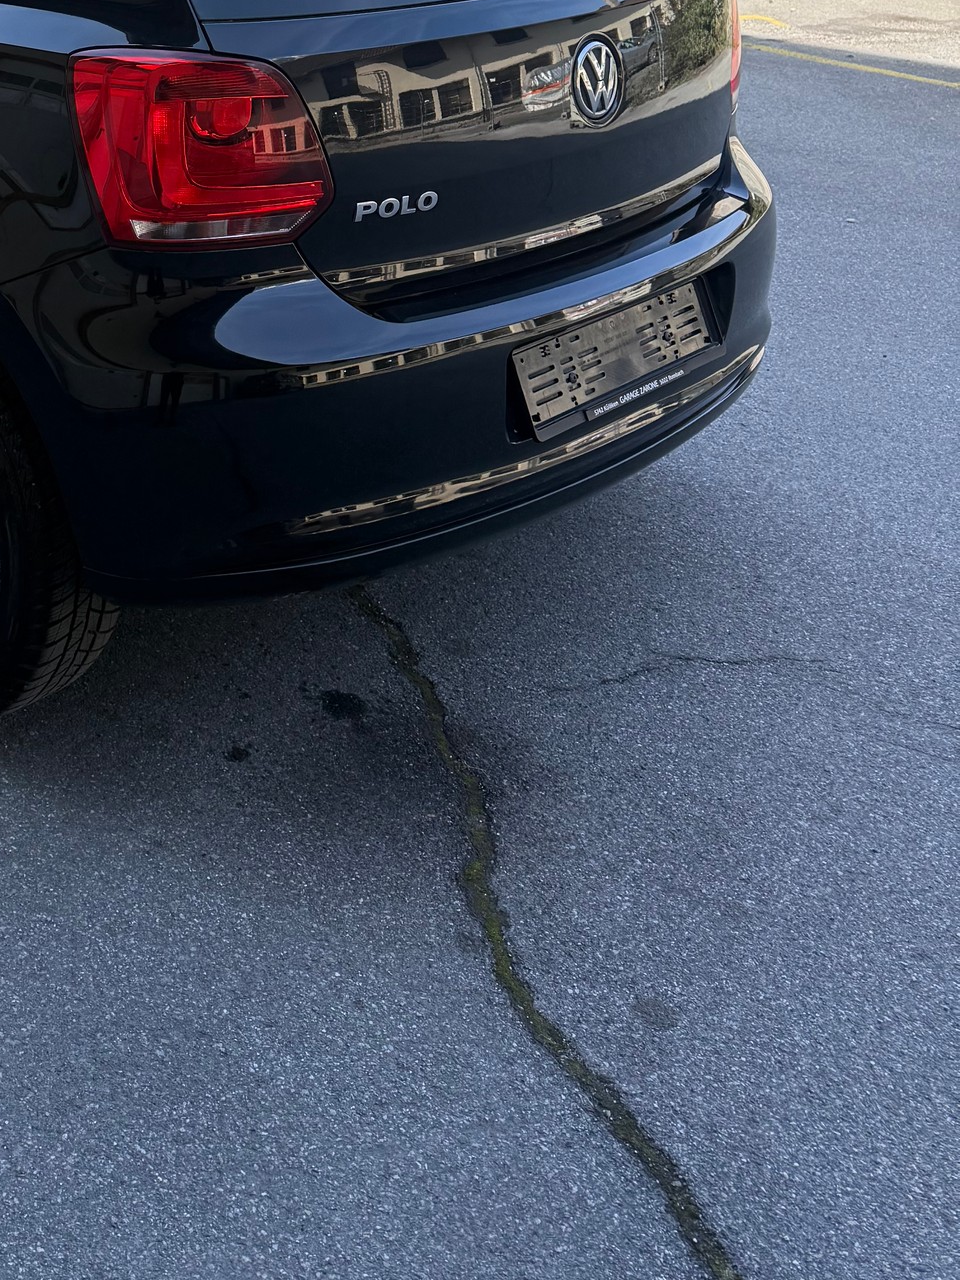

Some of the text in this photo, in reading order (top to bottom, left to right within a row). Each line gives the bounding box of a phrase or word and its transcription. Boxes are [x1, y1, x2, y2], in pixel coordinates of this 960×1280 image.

[354, 191, 439, 223] POLO
[619, 388, 640, 404] GARAGE
[639, 379, 660, 395] ZARONE
